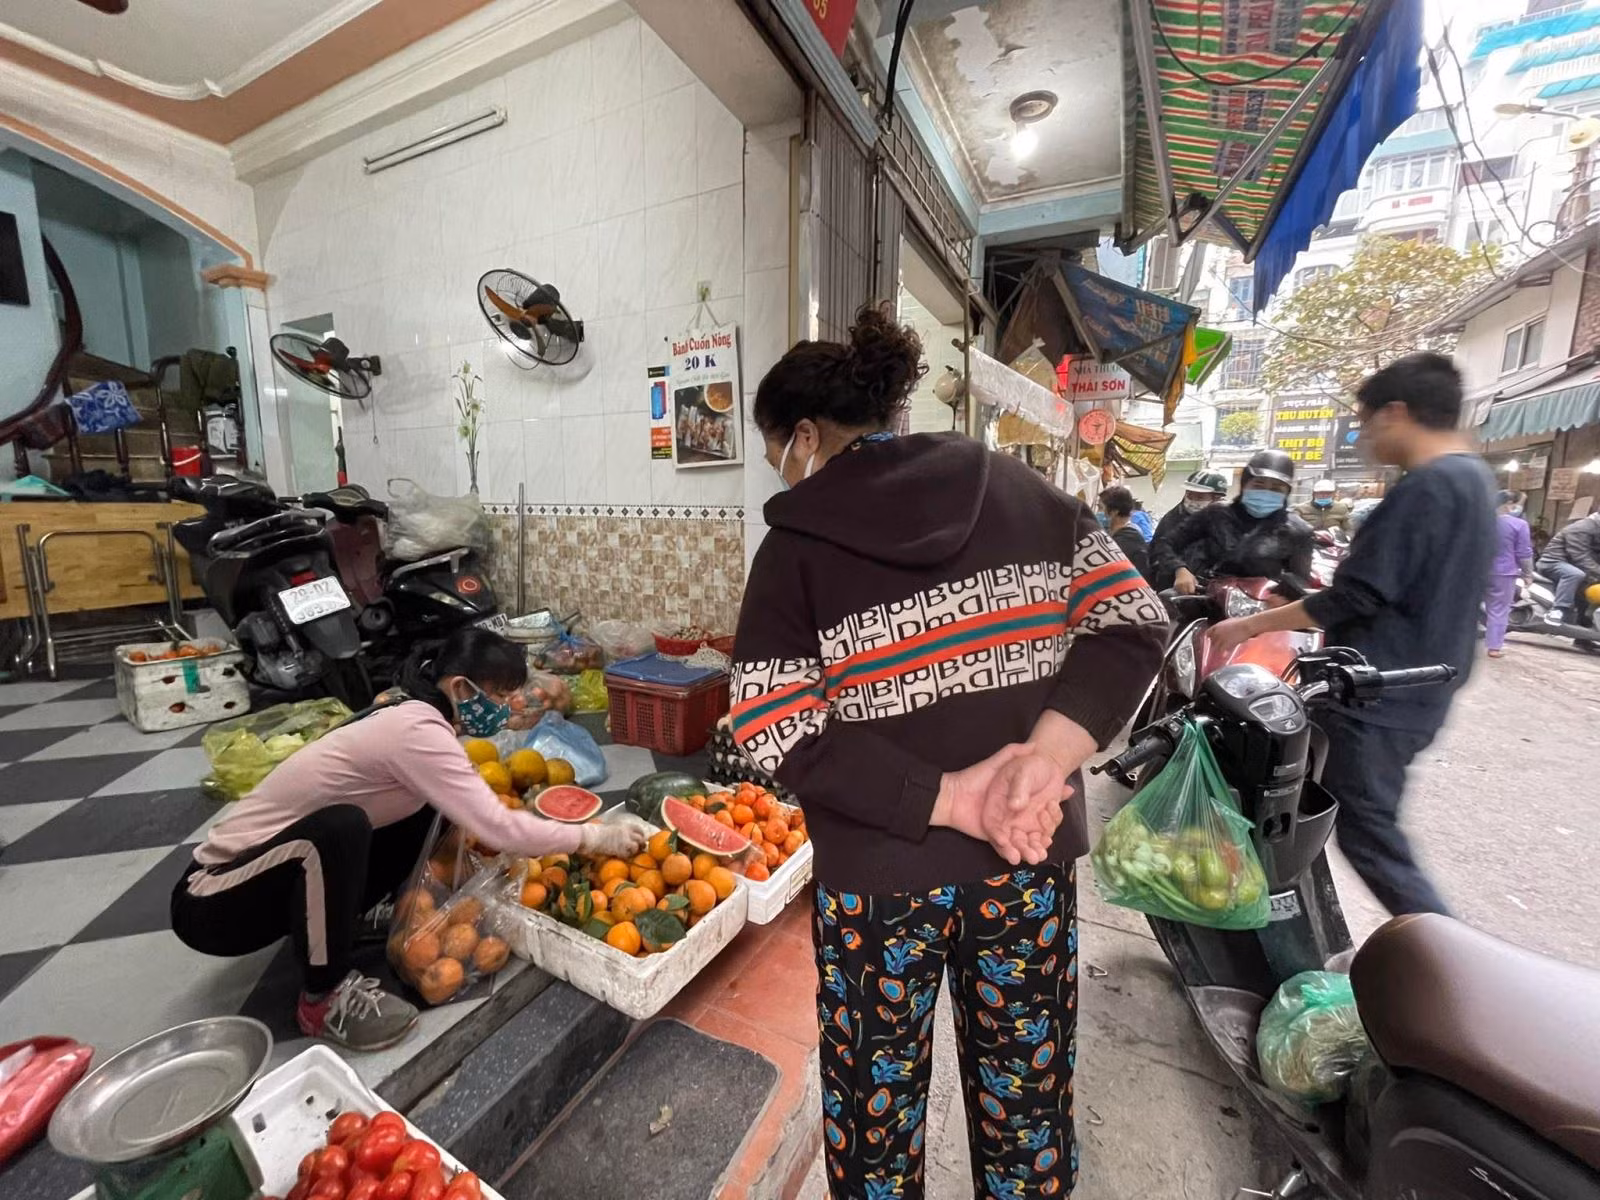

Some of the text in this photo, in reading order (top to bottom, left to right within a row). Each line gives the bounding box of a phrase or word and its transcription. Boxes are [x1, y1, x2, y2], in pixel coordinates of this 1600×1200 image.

[684, 354, 717, 371] 20 K
[1103, 378, 1126, 391] SƠN
